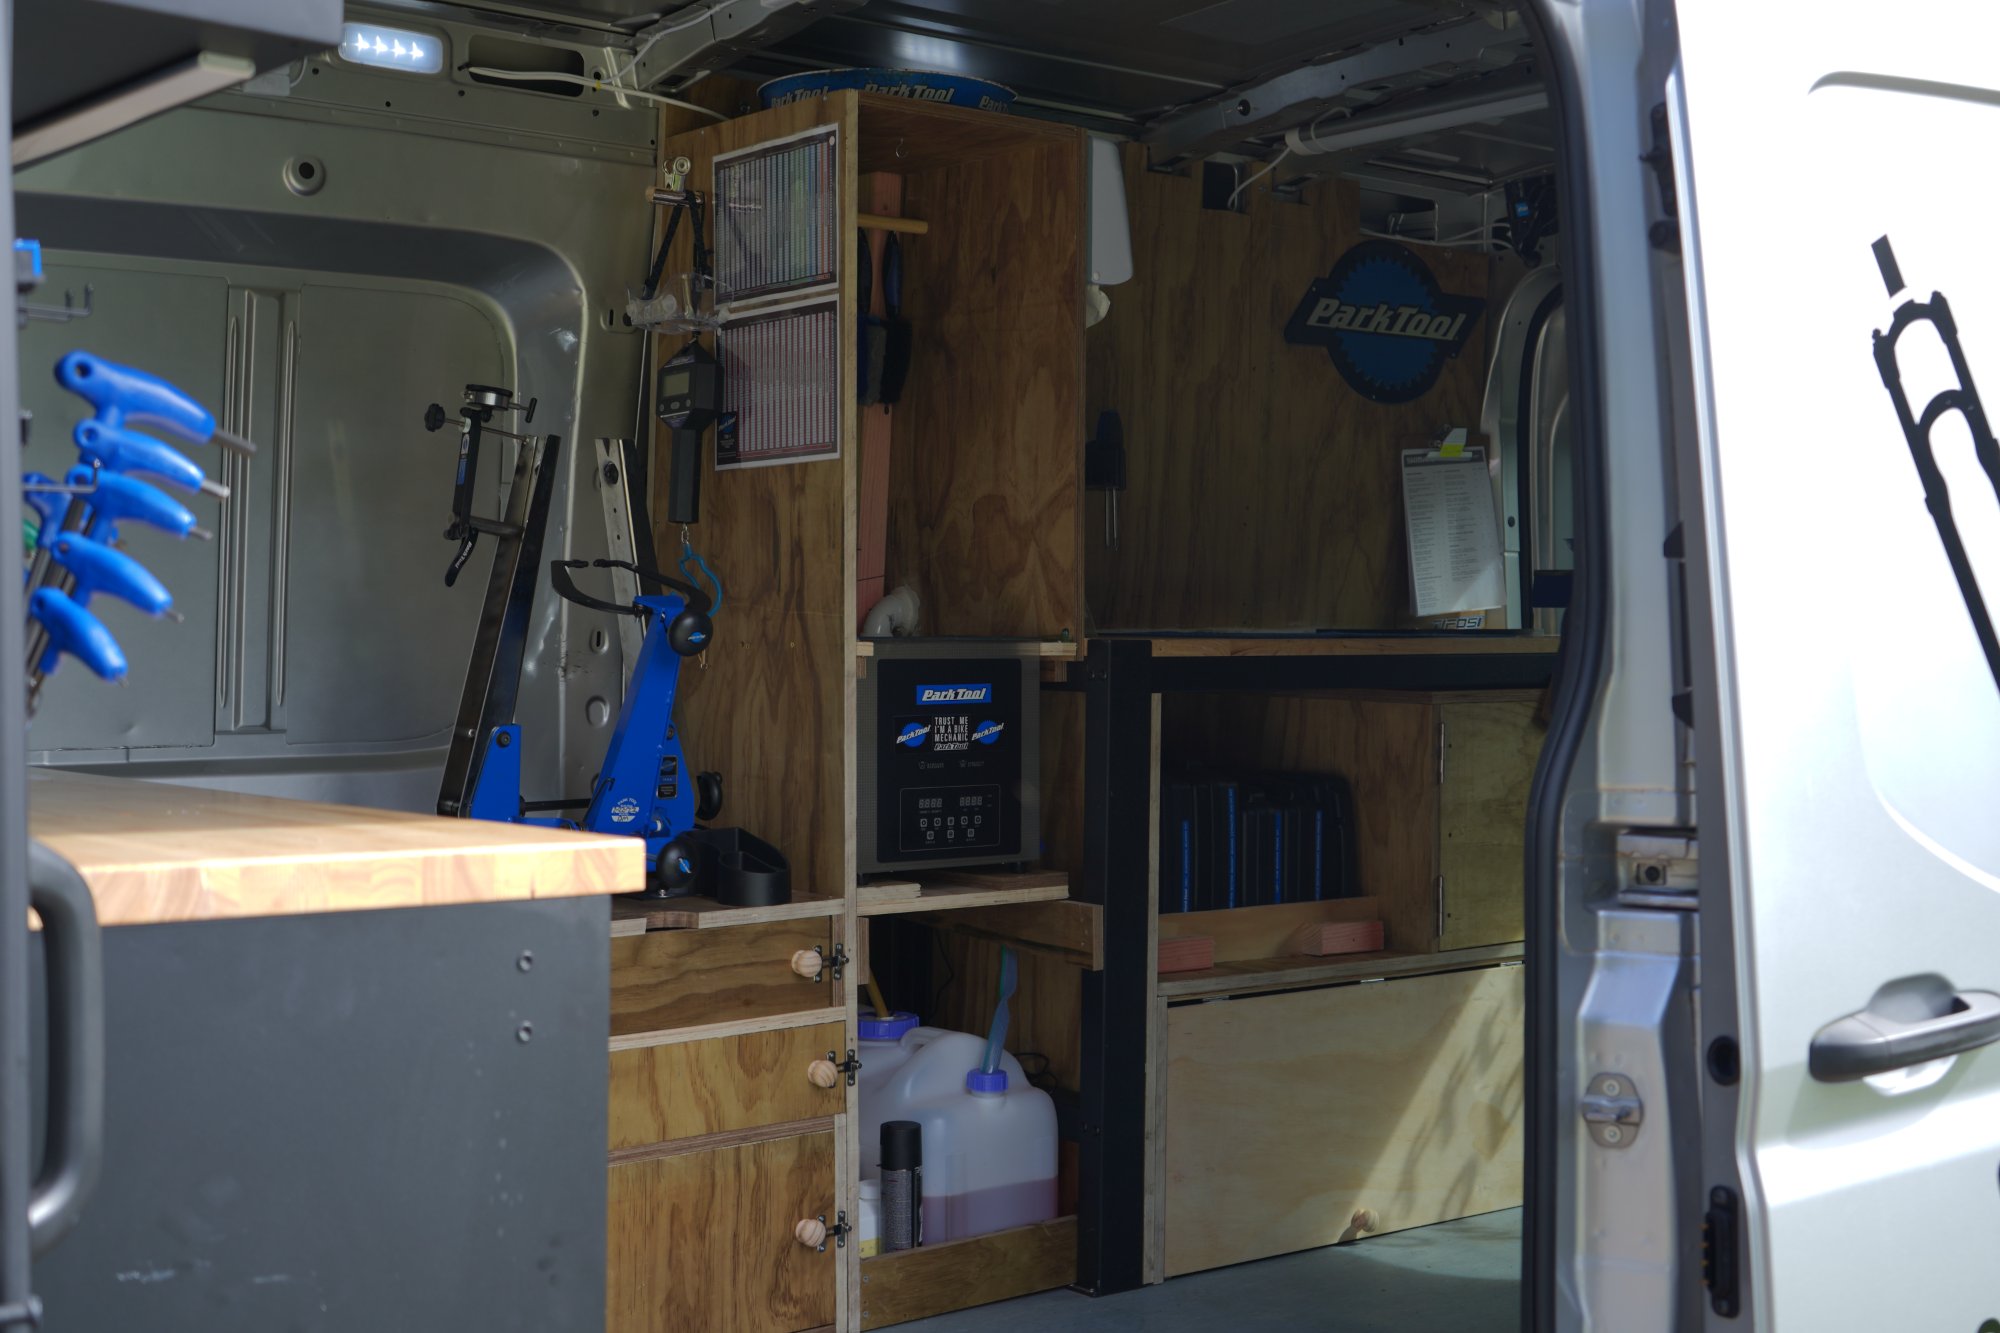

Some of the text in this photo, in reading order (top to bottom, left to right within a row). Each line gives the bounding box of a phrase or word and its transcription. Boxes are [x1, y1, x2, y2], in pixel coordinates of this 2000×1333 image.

[934, 716, 969, 725] TRUST ME
[934, 724, 969, 733] I'M A BIKE
[934, 732, 969, 742] MECHANIC
